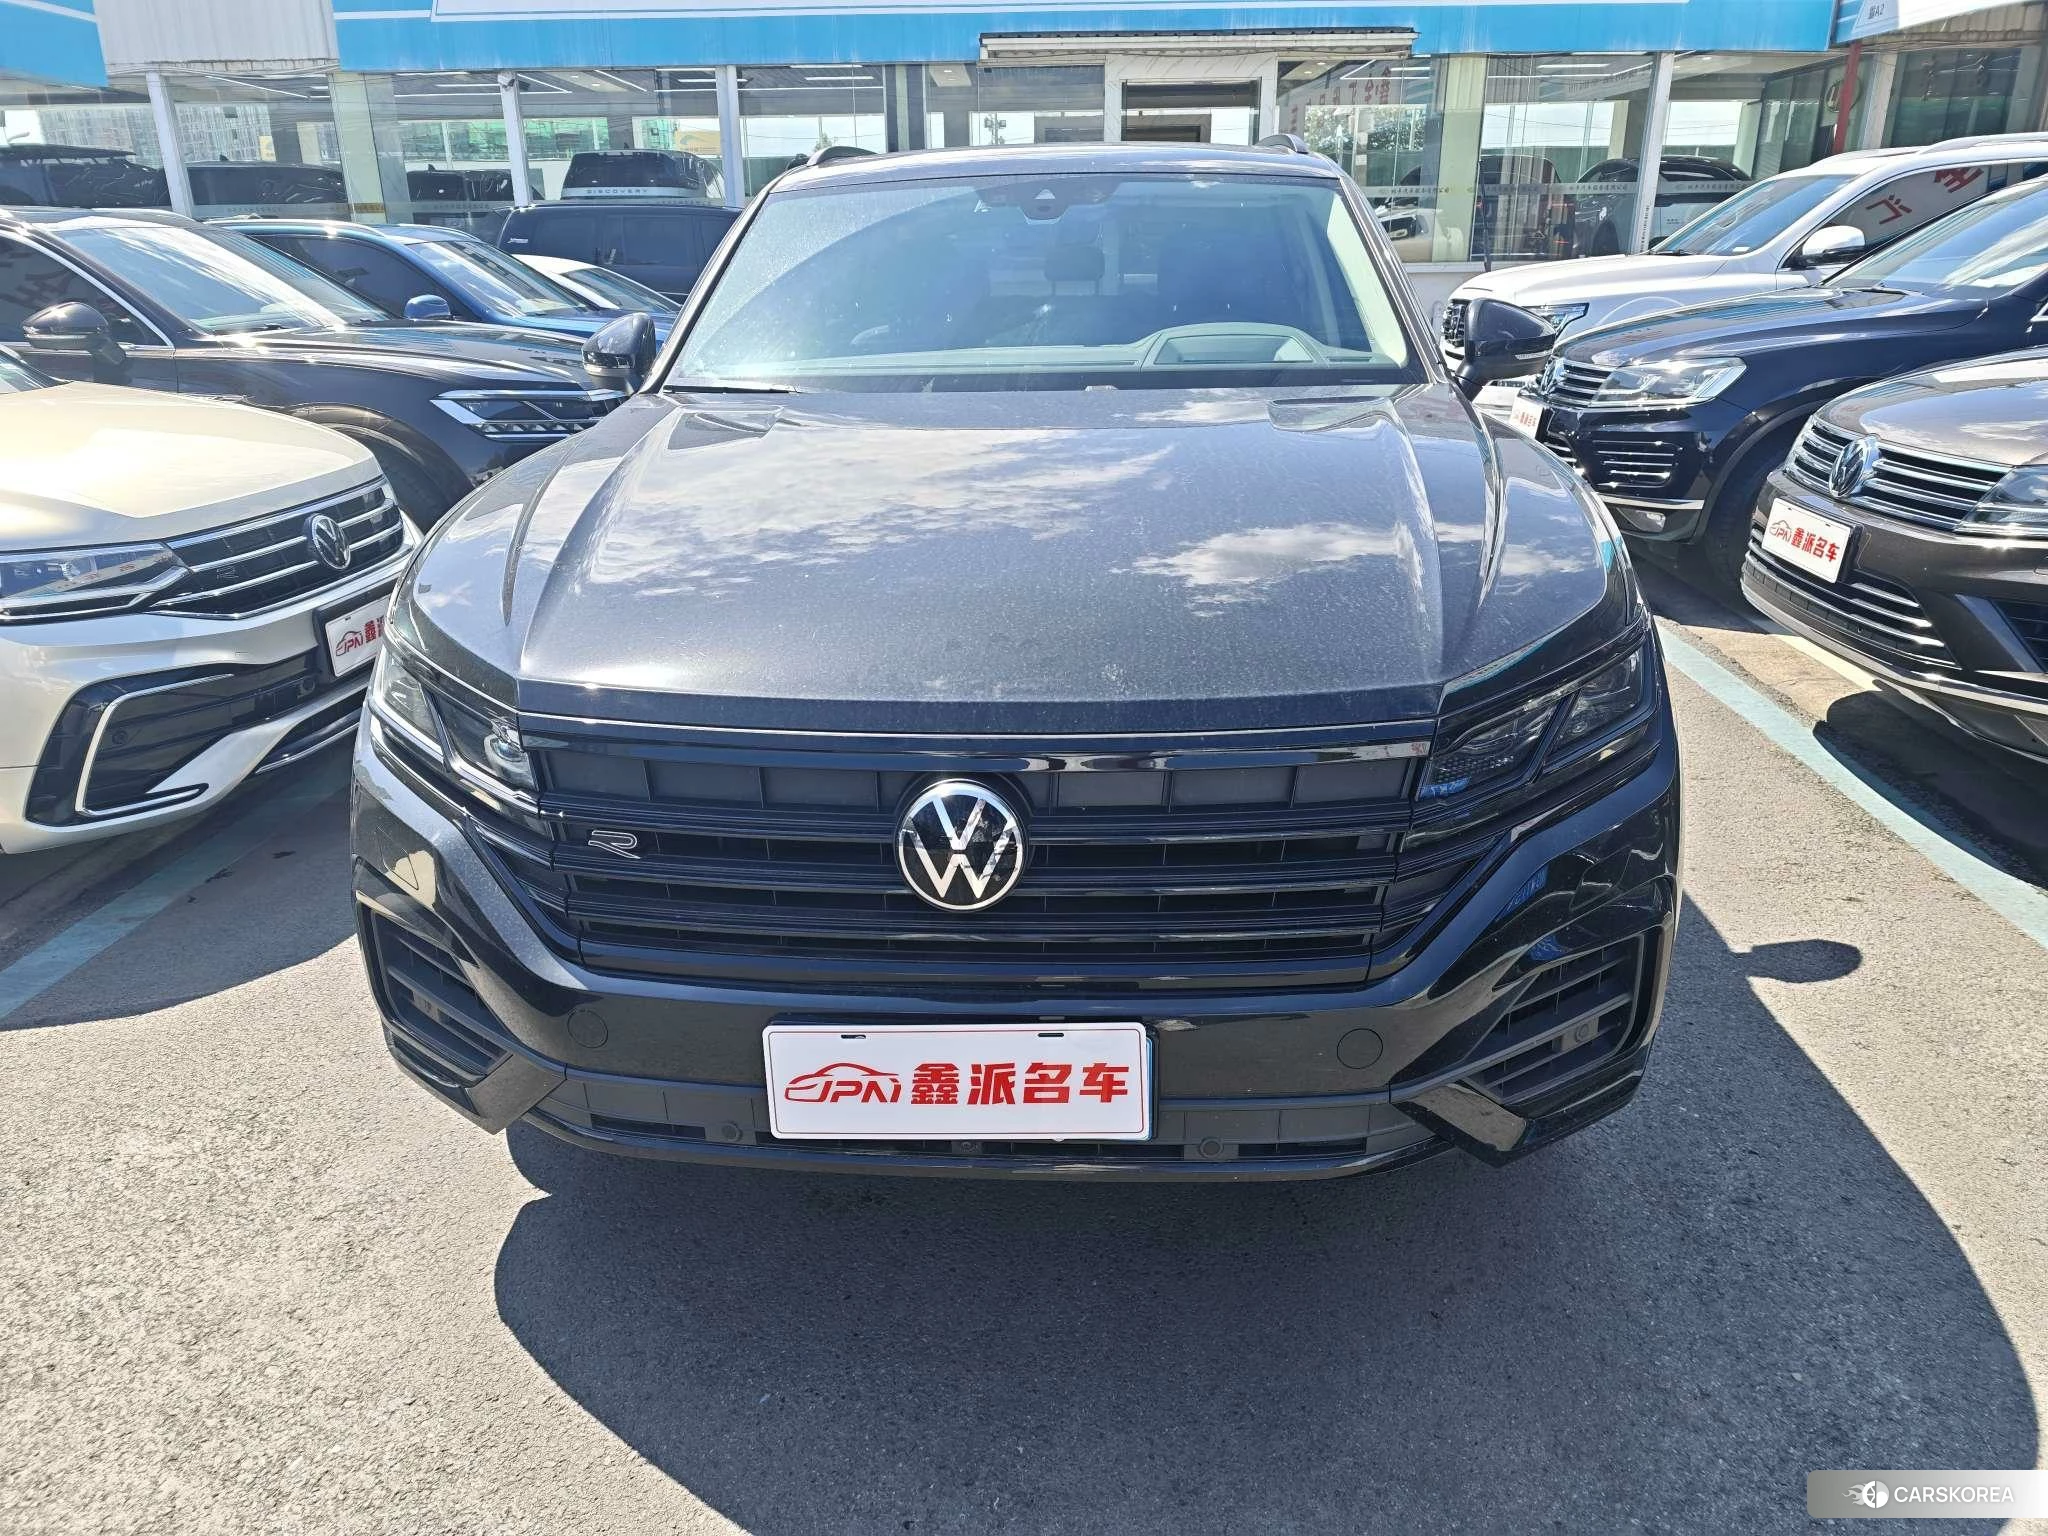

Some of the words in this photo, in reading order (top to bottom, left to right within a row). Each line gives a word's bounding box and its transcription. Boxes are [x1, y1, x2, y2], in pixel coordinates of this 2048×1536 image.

[1791, 527, 1841, 562] 鑫派名车
[911, 1062, 1129, 1105] 鑫派名车
